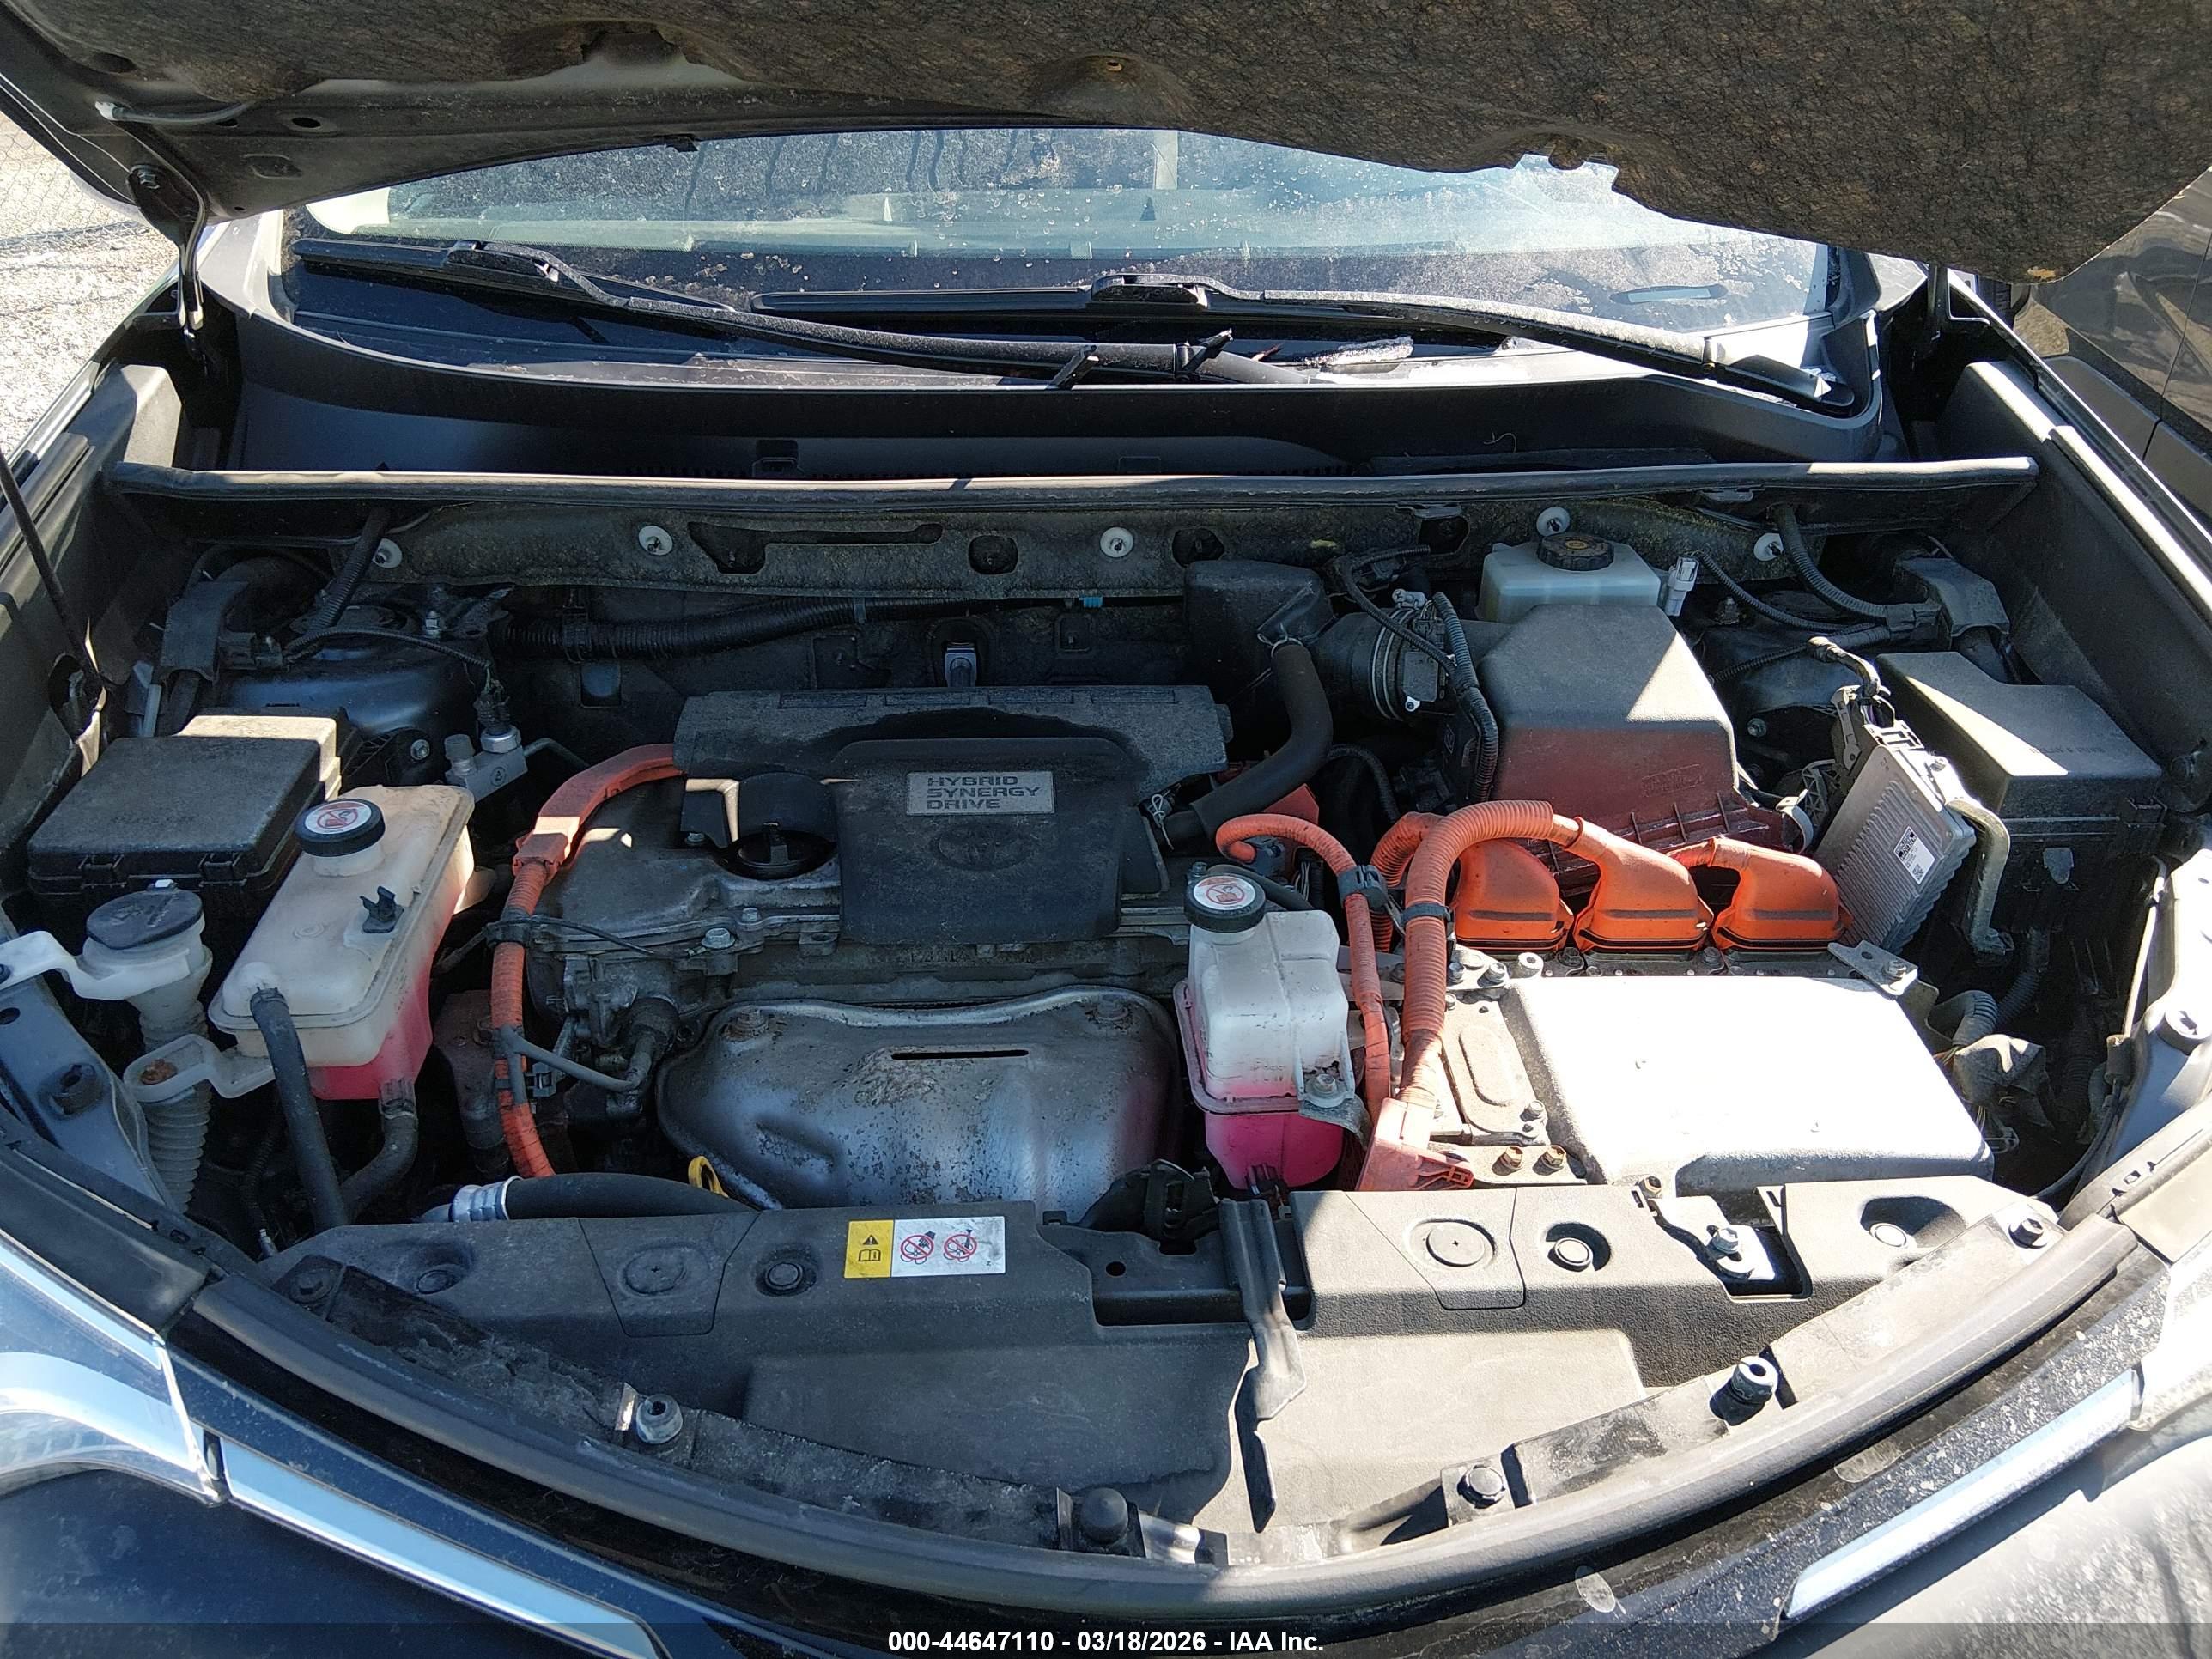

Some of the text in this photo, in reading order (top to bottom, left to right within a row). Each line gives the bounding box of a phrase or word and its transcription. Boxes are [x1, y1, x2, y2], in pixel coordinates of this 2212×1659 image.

[927, 775, 1018, 787] HYBRID
[927, 787, 1042, 798] SYNERGY
[927, 799, 1000, 810] DRIVE
